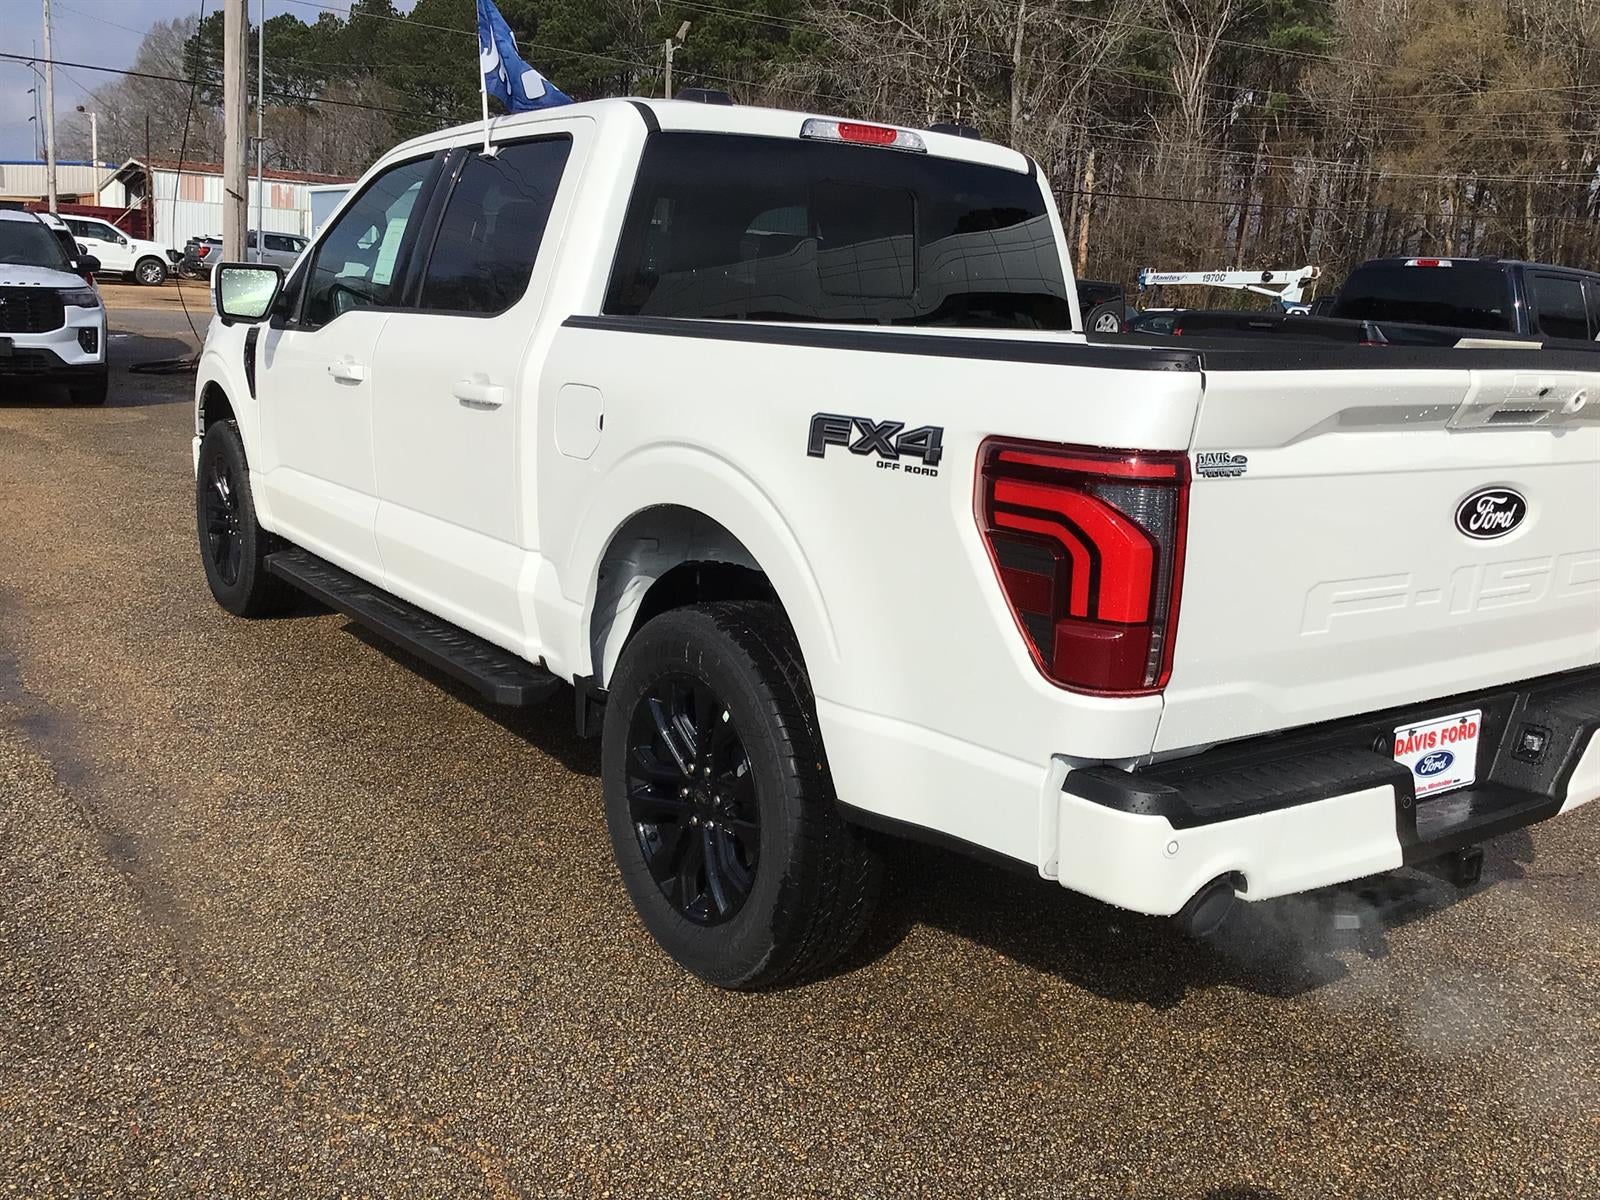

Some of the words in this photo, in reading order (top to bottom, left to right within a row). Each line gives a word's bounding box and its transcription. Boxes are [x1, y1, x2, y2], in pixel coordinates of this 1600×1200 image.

[1202, 273, 1226, 283] 1970C
[807, 412, 944, 467] FX4
[876, 460, 900, 471] OFF
[904, 465, 938, 477] ROAD
[1197, 452, 1231, 465] DAVIS
[1469, 496, 1517, 530] Ford
[1395, 731, 1437, 756] DAVIS
[1440, 722, 1477, 746] FORD
[1420, 753, 1447, 774] Ford
